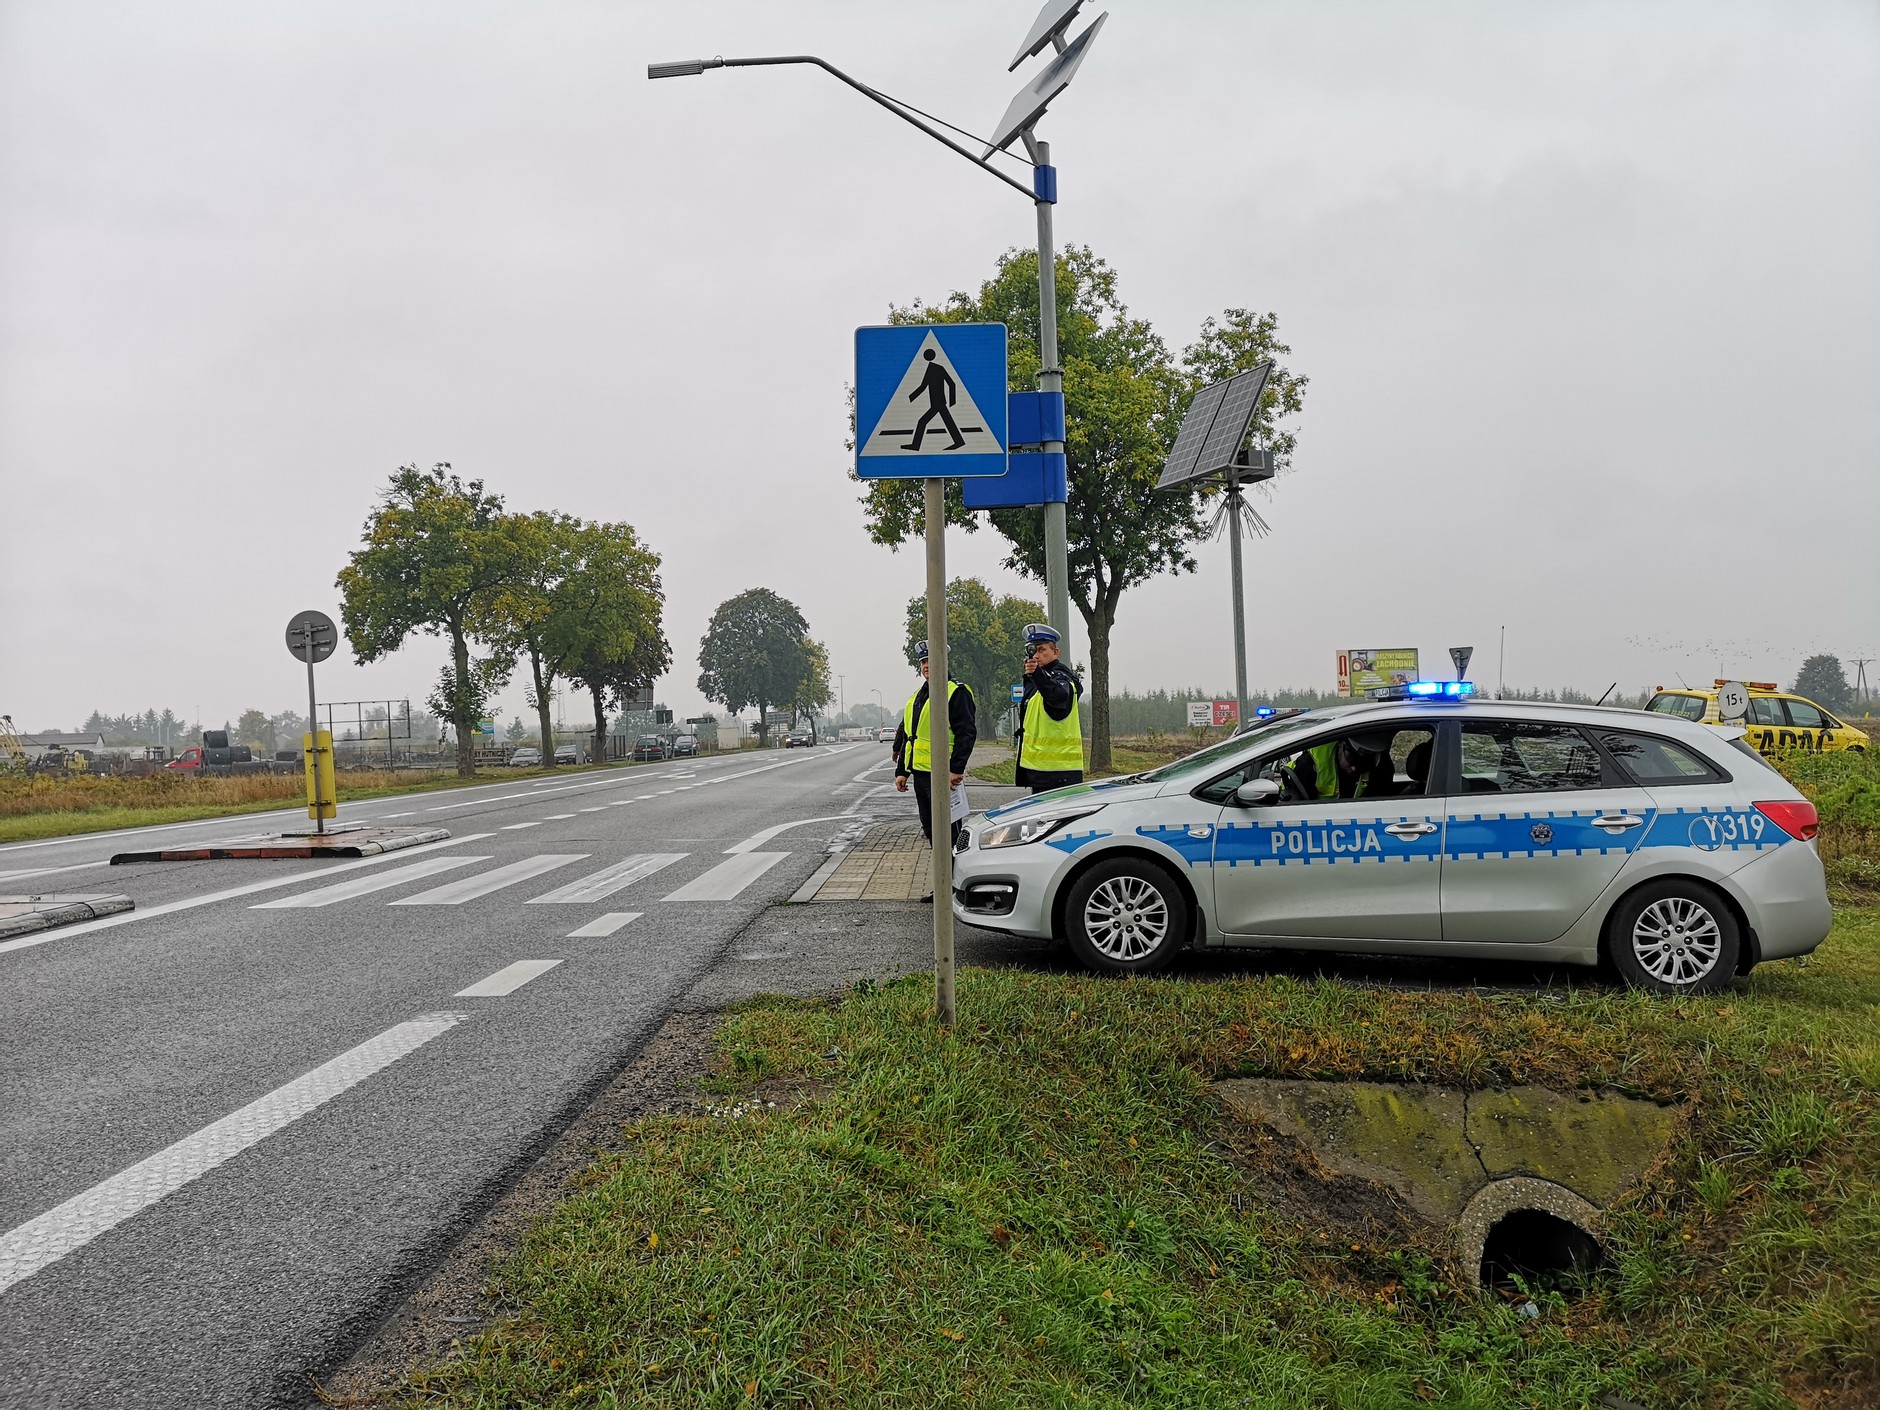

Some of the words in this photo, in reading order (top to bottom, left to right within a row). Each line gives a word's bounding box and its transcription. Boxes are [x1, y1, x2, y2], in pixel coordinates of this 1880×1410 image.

[1376, 659, 1415, 669] ZACHODNIE
[1726, 693, 1738, 706] 15
[1759, 729, 1834, 755] ADAC
[1271, 829, 1381, 854] POLICJA
